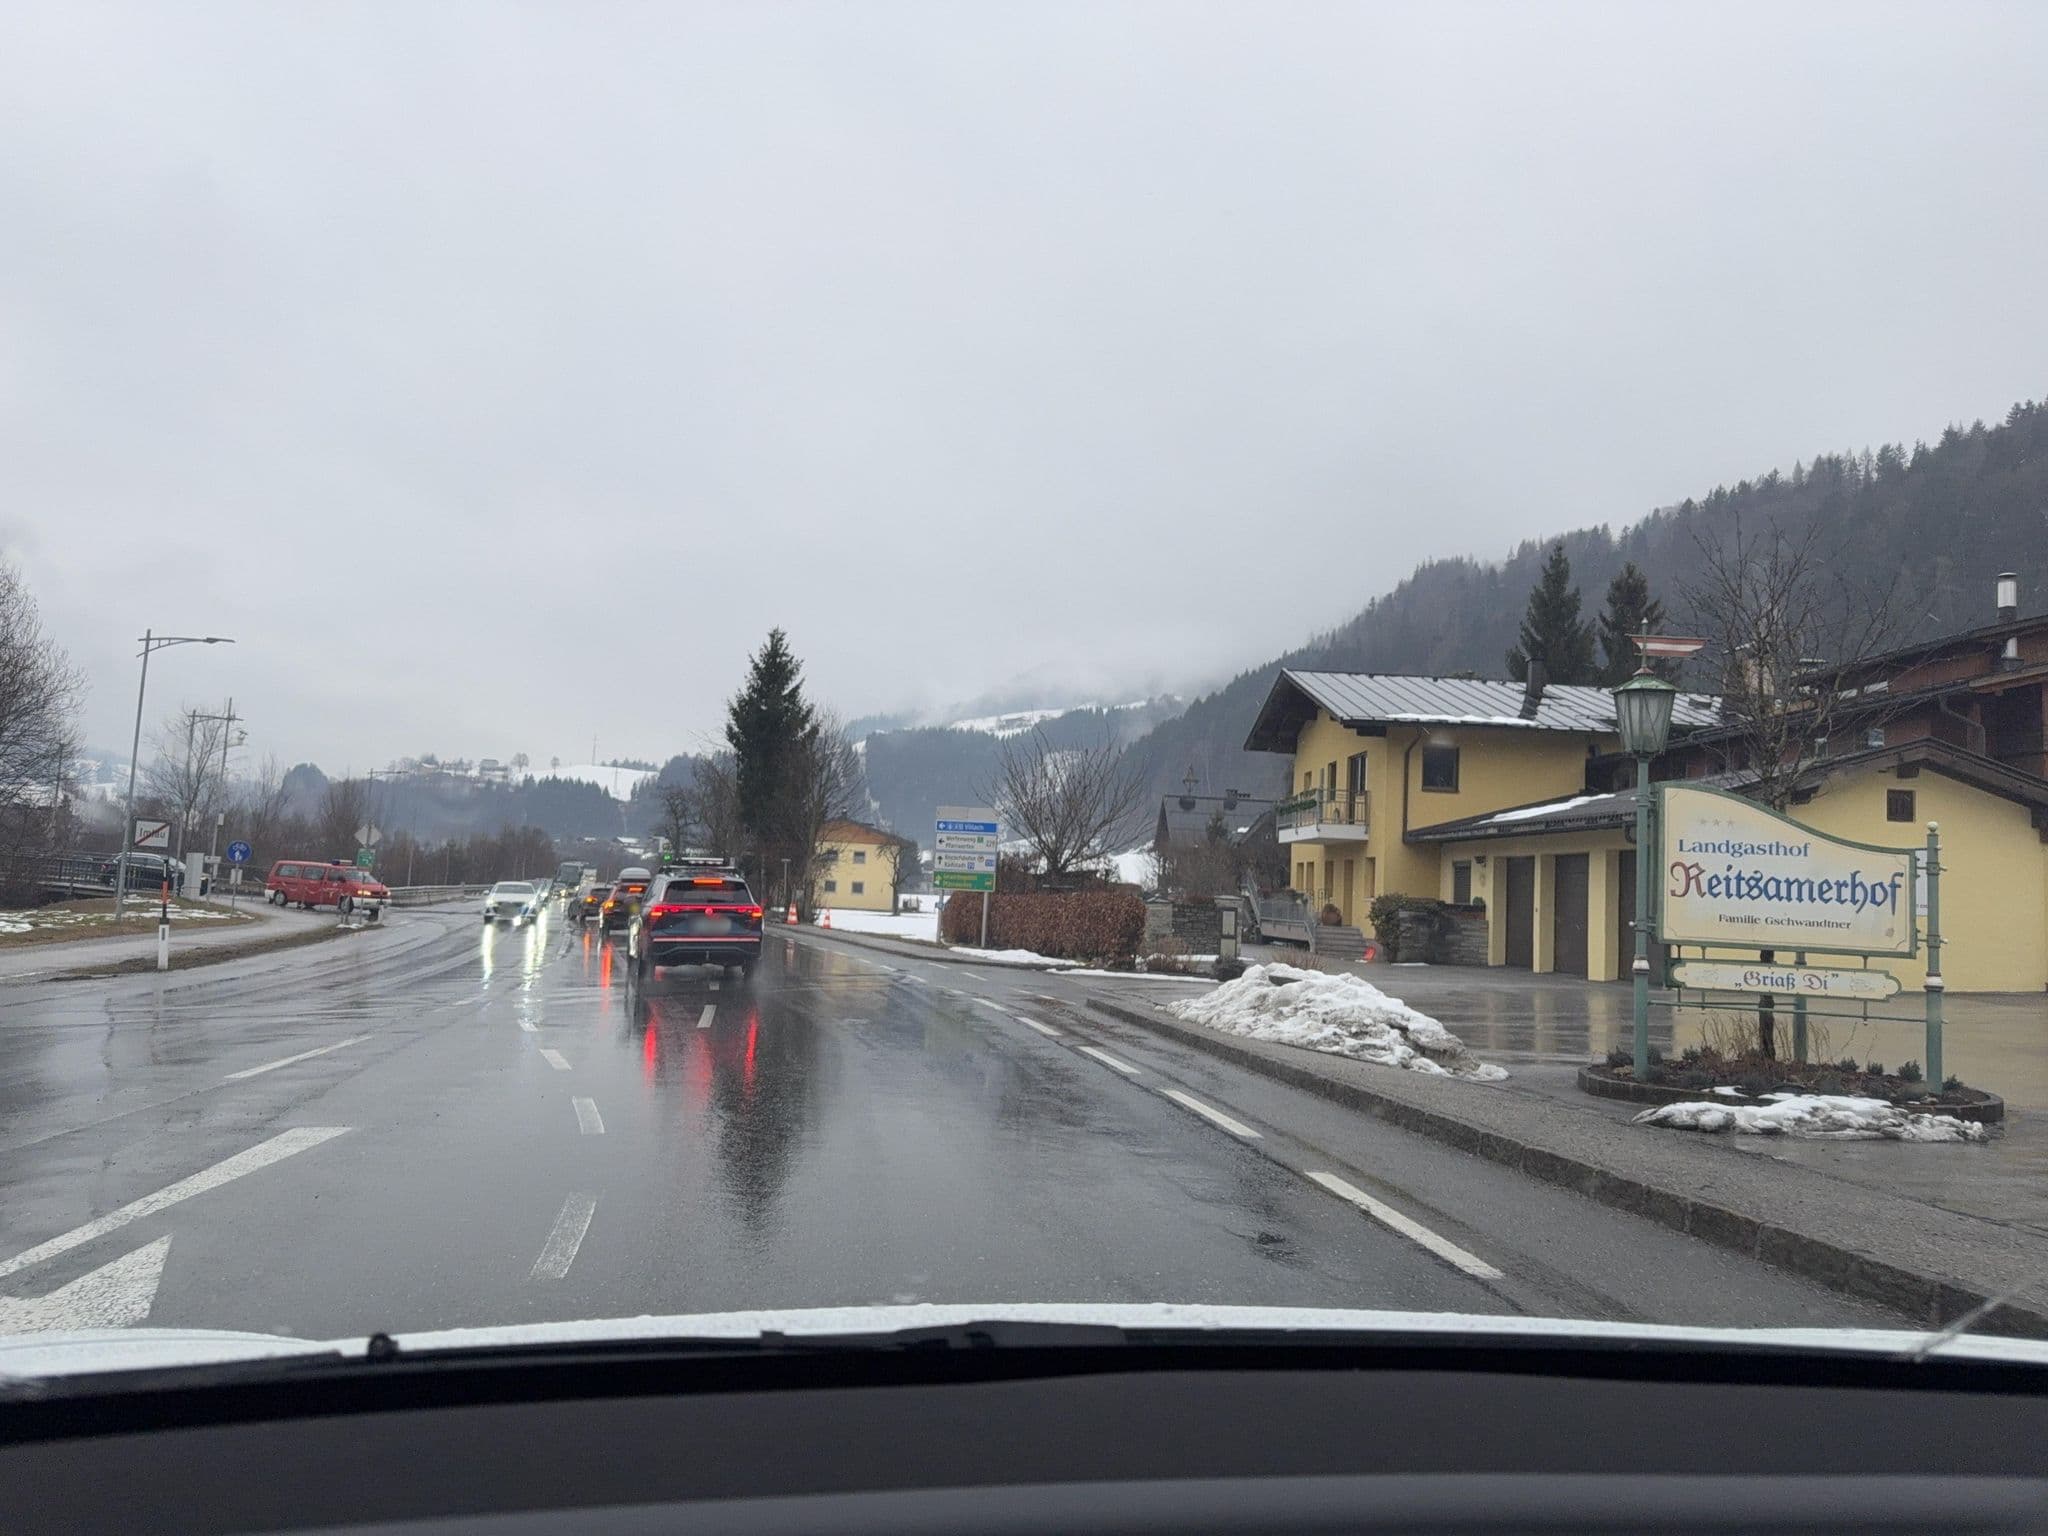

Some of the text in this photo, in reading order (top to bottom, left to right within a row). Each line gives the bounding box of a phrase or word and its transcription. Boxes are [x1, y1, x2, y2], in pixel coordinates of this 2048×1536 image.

[1678, 838, 1811, 858] Landgasthof
[1670, 861, 1904, 916] Reitsamerhof
[1719, 913, 1852, 930] Familie Gschwandtner
